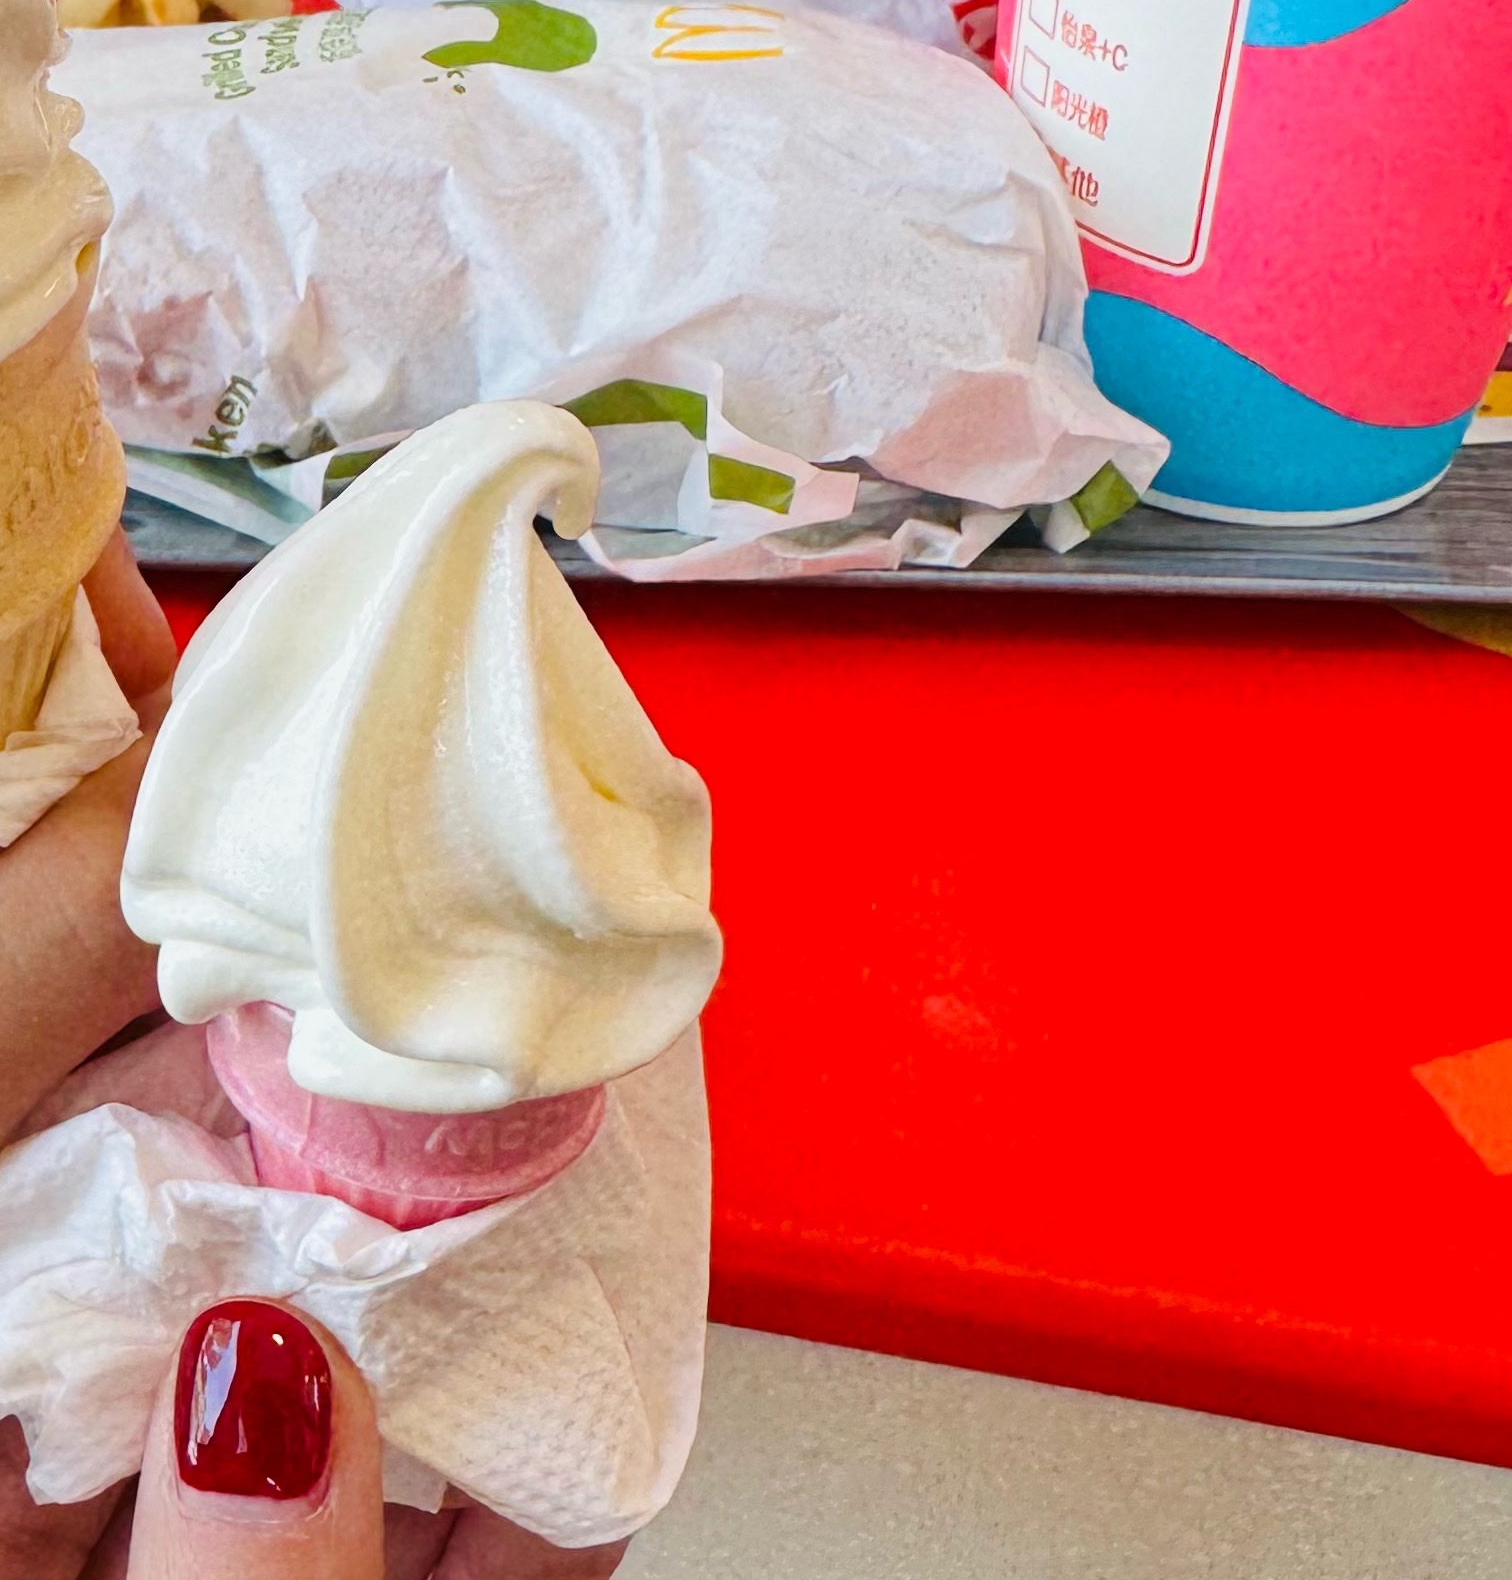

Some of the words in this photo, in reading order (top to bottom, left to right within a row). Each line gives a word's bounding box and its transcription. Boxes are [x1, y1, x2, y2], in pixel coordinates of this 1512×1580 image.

[1061, 9, 1129, 72] 怡泉+C
[1050, 79, 1109, 141] 阳光橙
